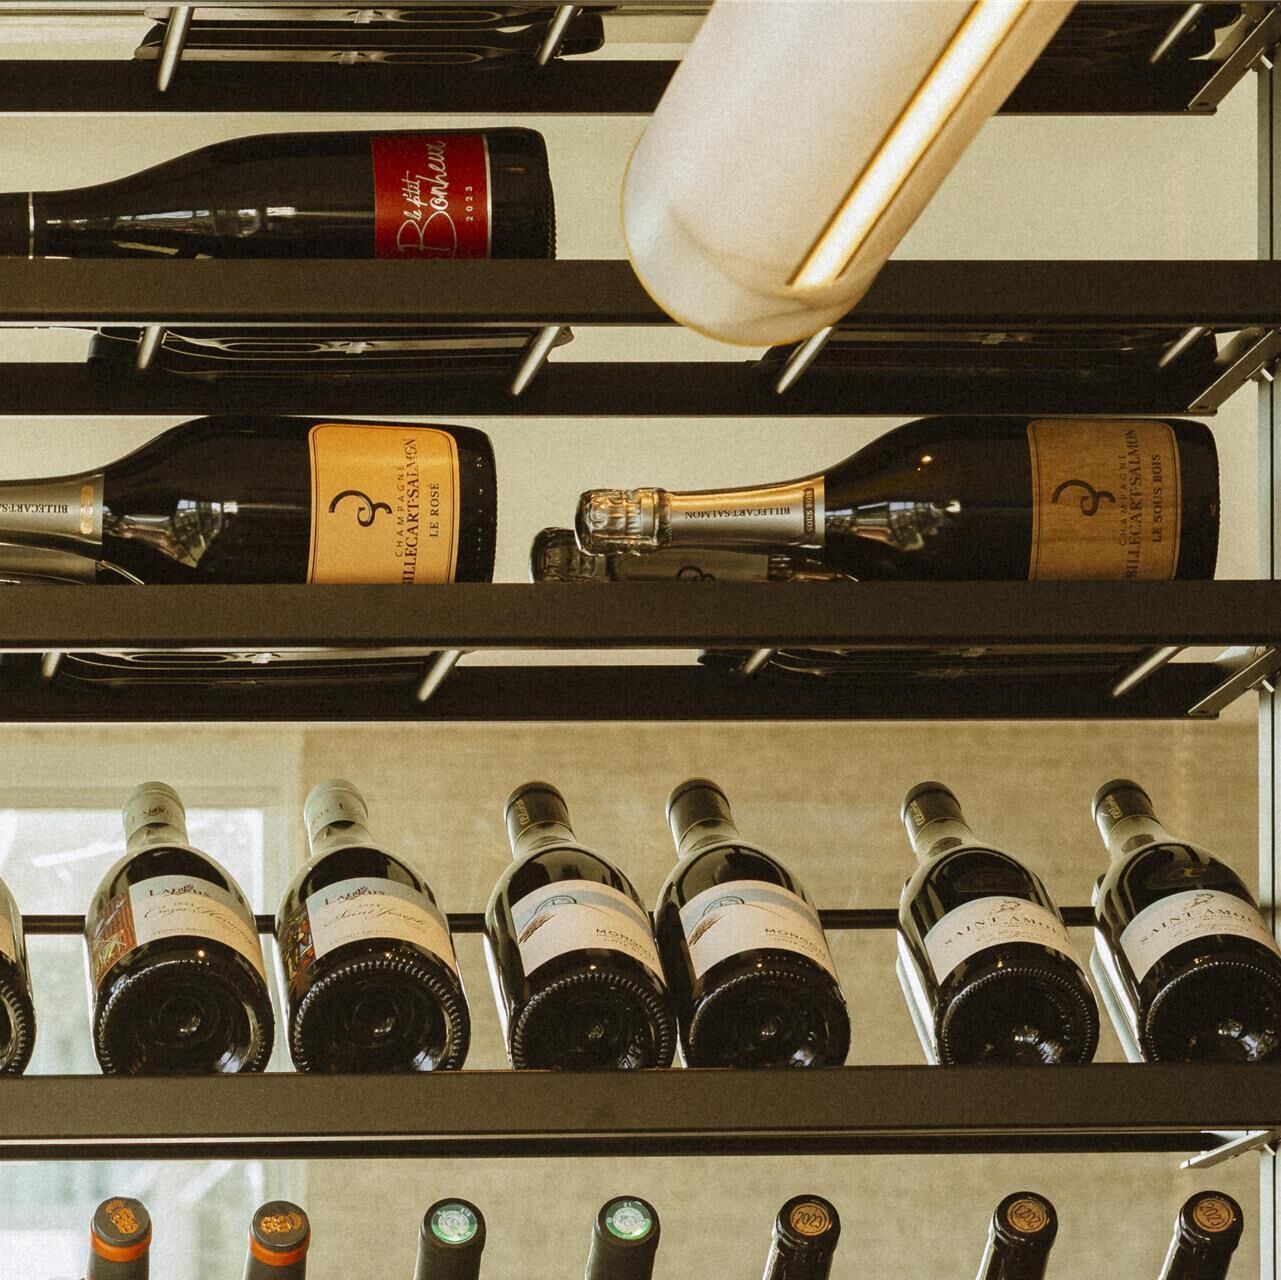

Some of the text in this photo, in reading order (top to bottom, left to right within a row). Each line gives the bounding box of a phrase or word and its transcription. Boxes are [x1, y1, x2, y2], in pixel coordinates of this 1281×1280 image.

[397, 140, 457, 259] Bonheur
[465, 186, 474, 222] 2023
[395, 465, 405, 558] CHAMPAGNE
[426, 482, 440, 538] LE ROSÉ
[1119, 454, 1128, 546] CHAMPAGNE
[1151, 454, 1164, 543] LE SOUS BOIS
[795, 1210, 824, 1228] 2023
[1199, 1202, 1225, 1226] 2023
